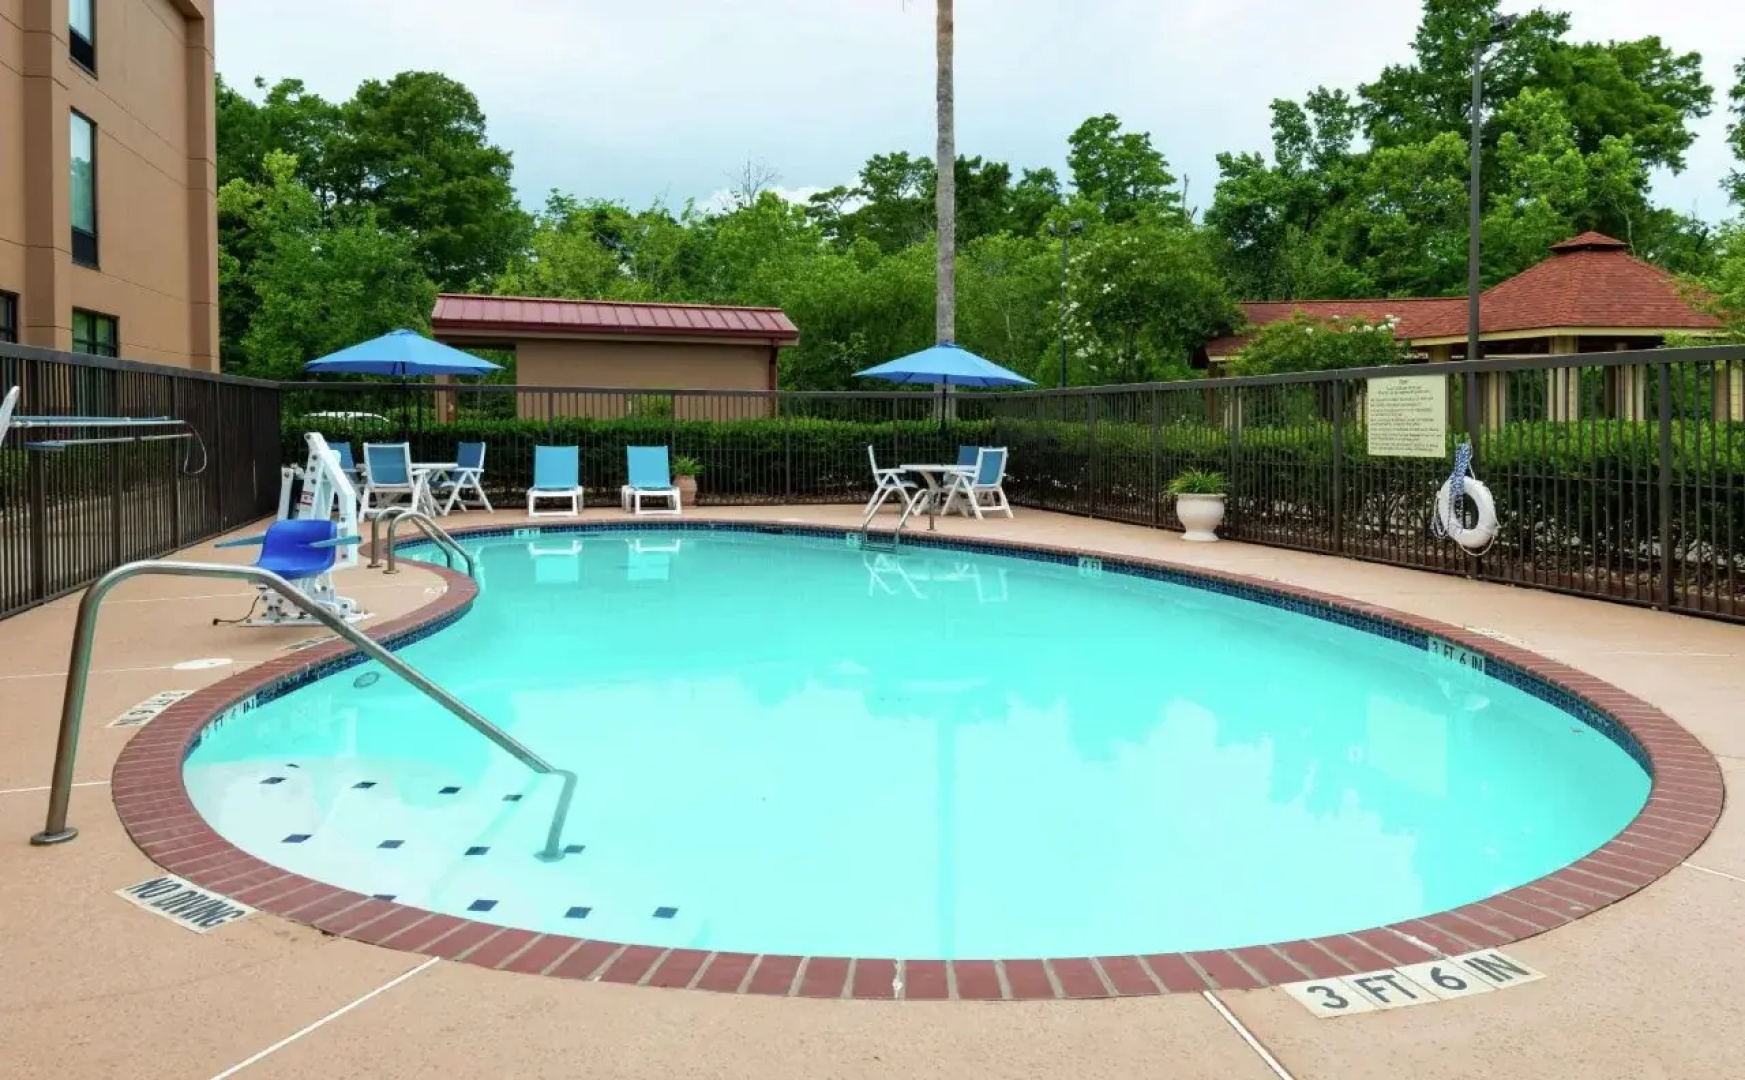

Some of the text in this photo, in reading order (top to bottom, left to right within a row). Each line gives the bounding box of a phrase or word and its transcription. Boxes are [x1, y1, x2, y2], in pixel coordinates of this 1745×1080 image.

[1444, 644, 1455, 660] FT
[1460, 652, 1467, 664] 6
[1471, 655, 1483, 671] IN
[243, 698, 255, 714] IN
[124, 877, 246, 927] NO DIVING
[1306, 953, 1531, 1010] 3 FT 6 IN
